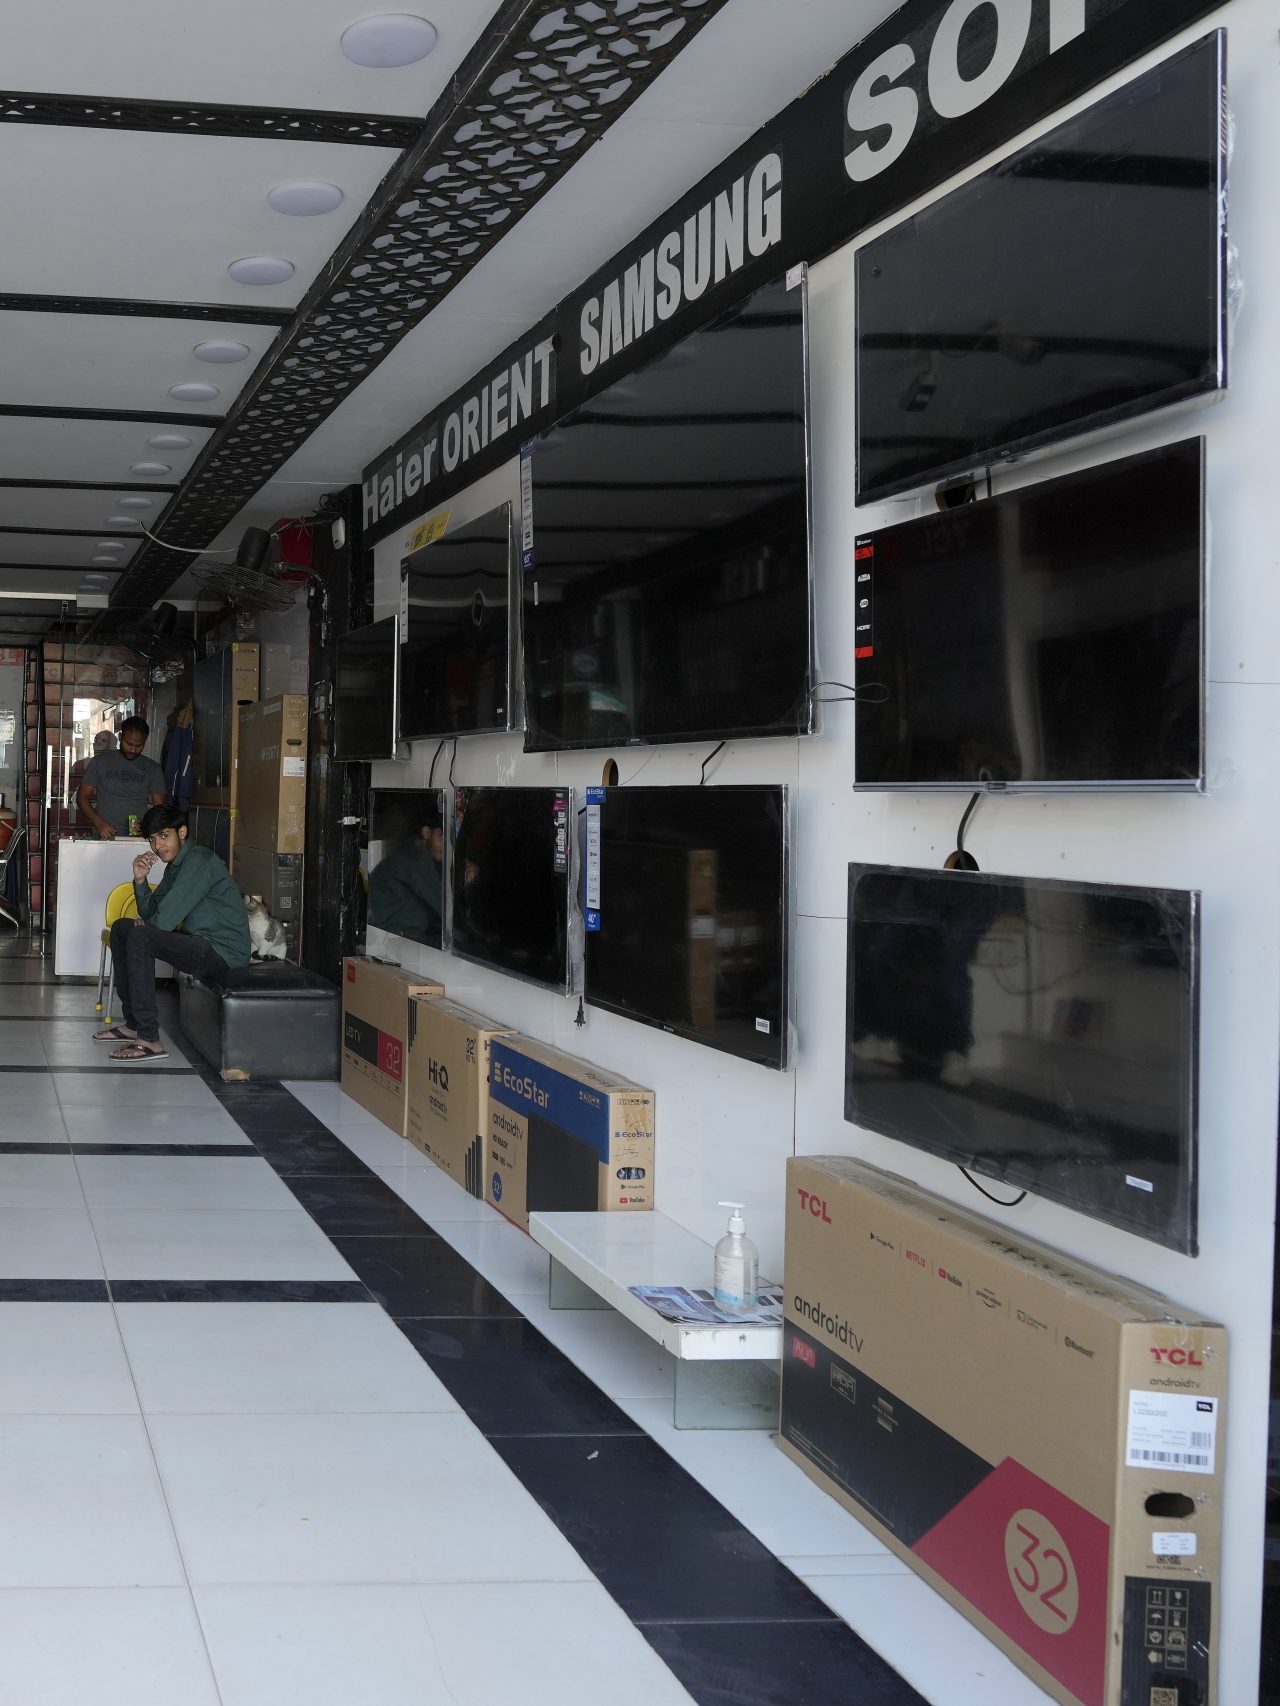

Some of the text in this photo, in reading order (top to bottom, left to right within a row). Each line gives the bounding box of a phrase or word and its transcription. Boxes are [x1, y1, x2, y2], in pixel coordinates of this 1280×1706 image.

[844, 0, 1085, 182] SO
[580, 153, 781, 375] SAMSUNG
[362, 335, 554, 532] Haier ORIENT
[386, 1042, 400, 1074] 32
[503, 1068, 550, 1109] EcoStar
[798, 1188, 832, 1224] TCL
[906, 1250, 926, 1268] NETFLIX
[794, 1295, 864, 1353] androidtv
[1150, 1348, 1202, 1366] TCL
[1014, 1522, 1068, 1622] 32
